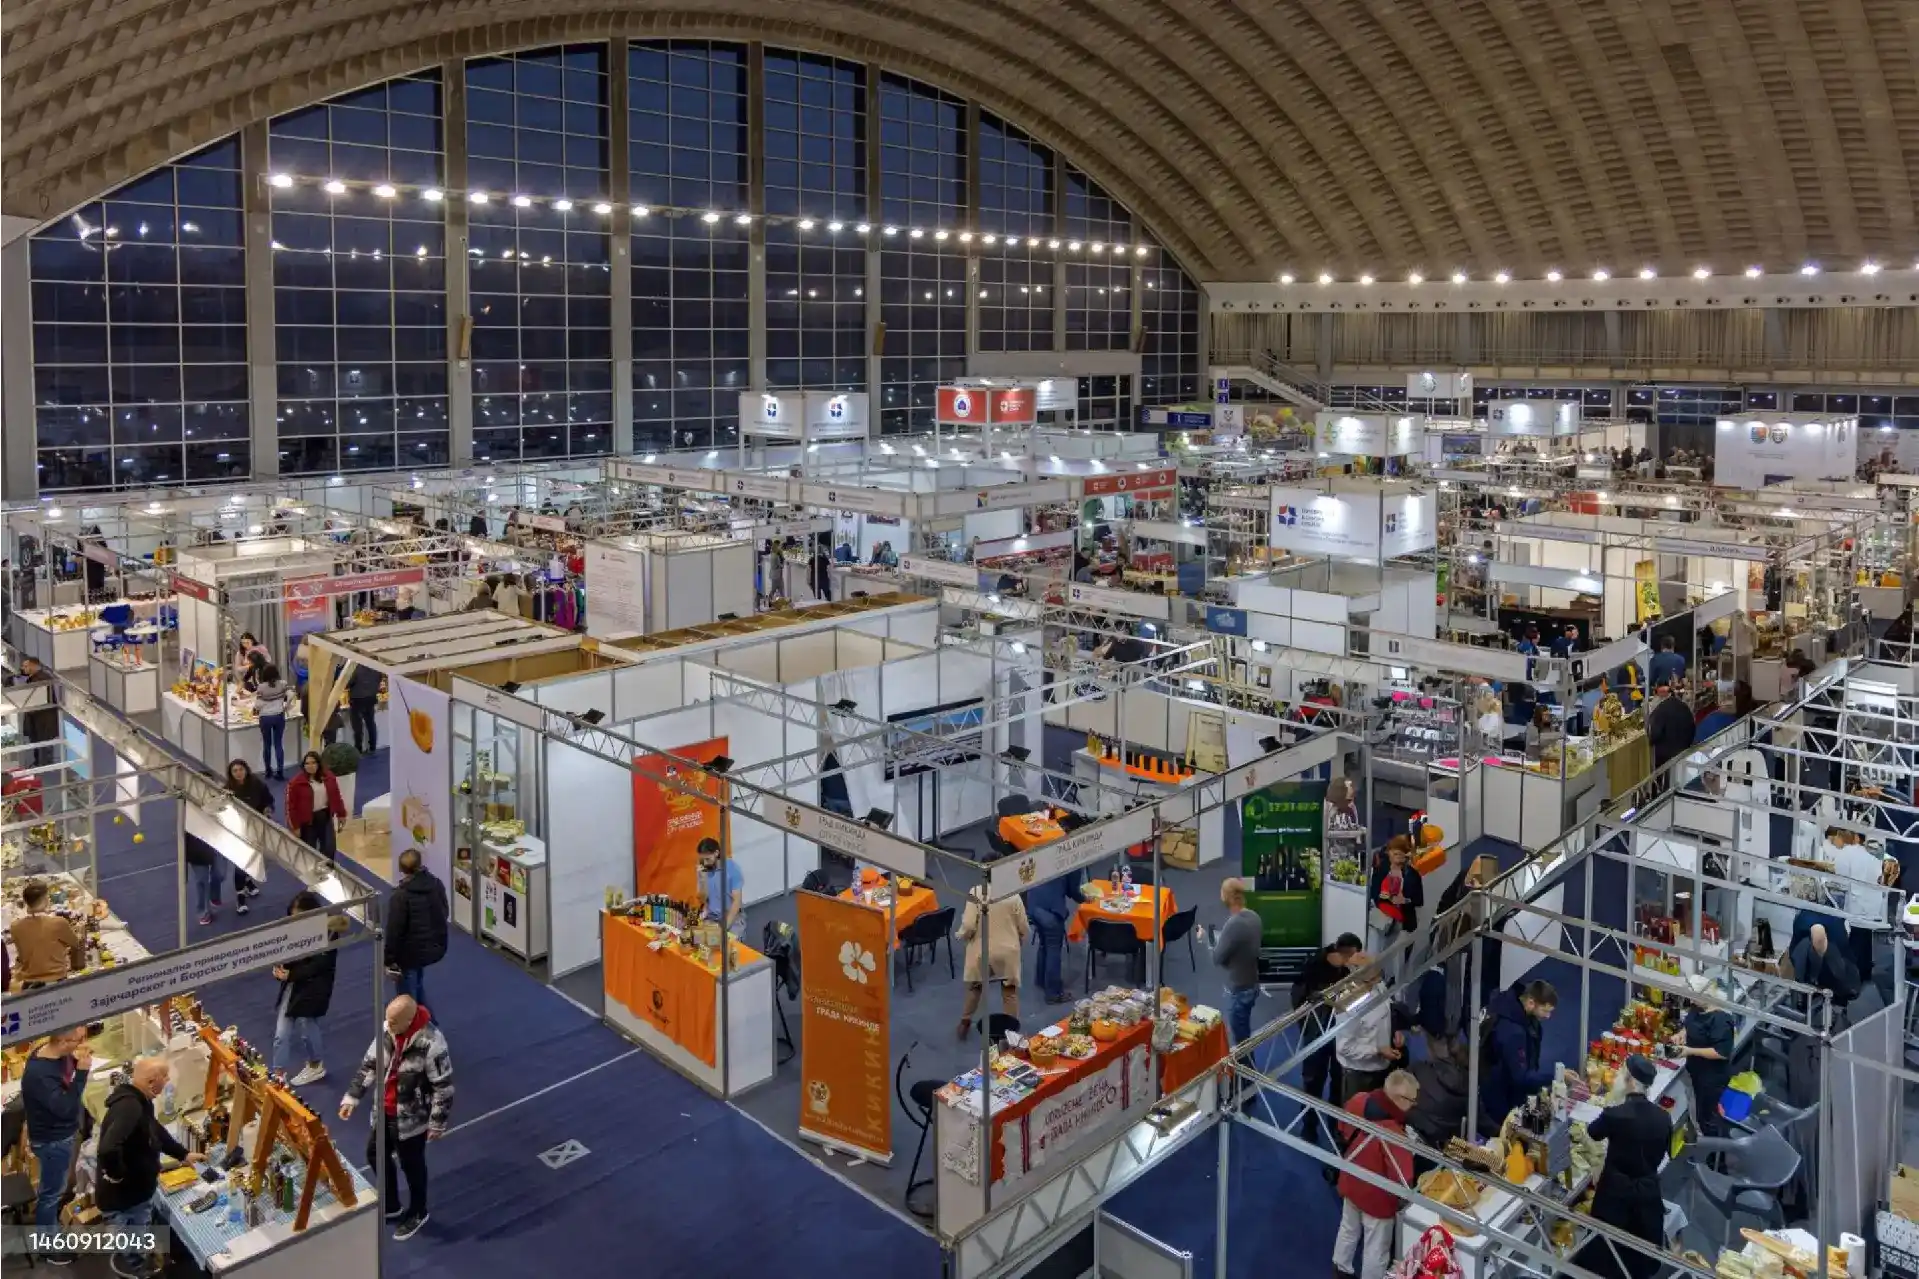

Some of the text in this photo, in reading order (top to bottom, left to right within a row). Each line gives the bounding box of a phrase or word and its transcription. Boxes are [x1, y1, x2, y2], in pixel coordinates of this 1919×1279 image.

[90, 934, 324, 1009] Зајечарског и Борског управног округа
[128, 933, 288, 985] Регионална привредна комора
[816, 1006, 880, 1033] ГРАДА КИКИНДЕ
